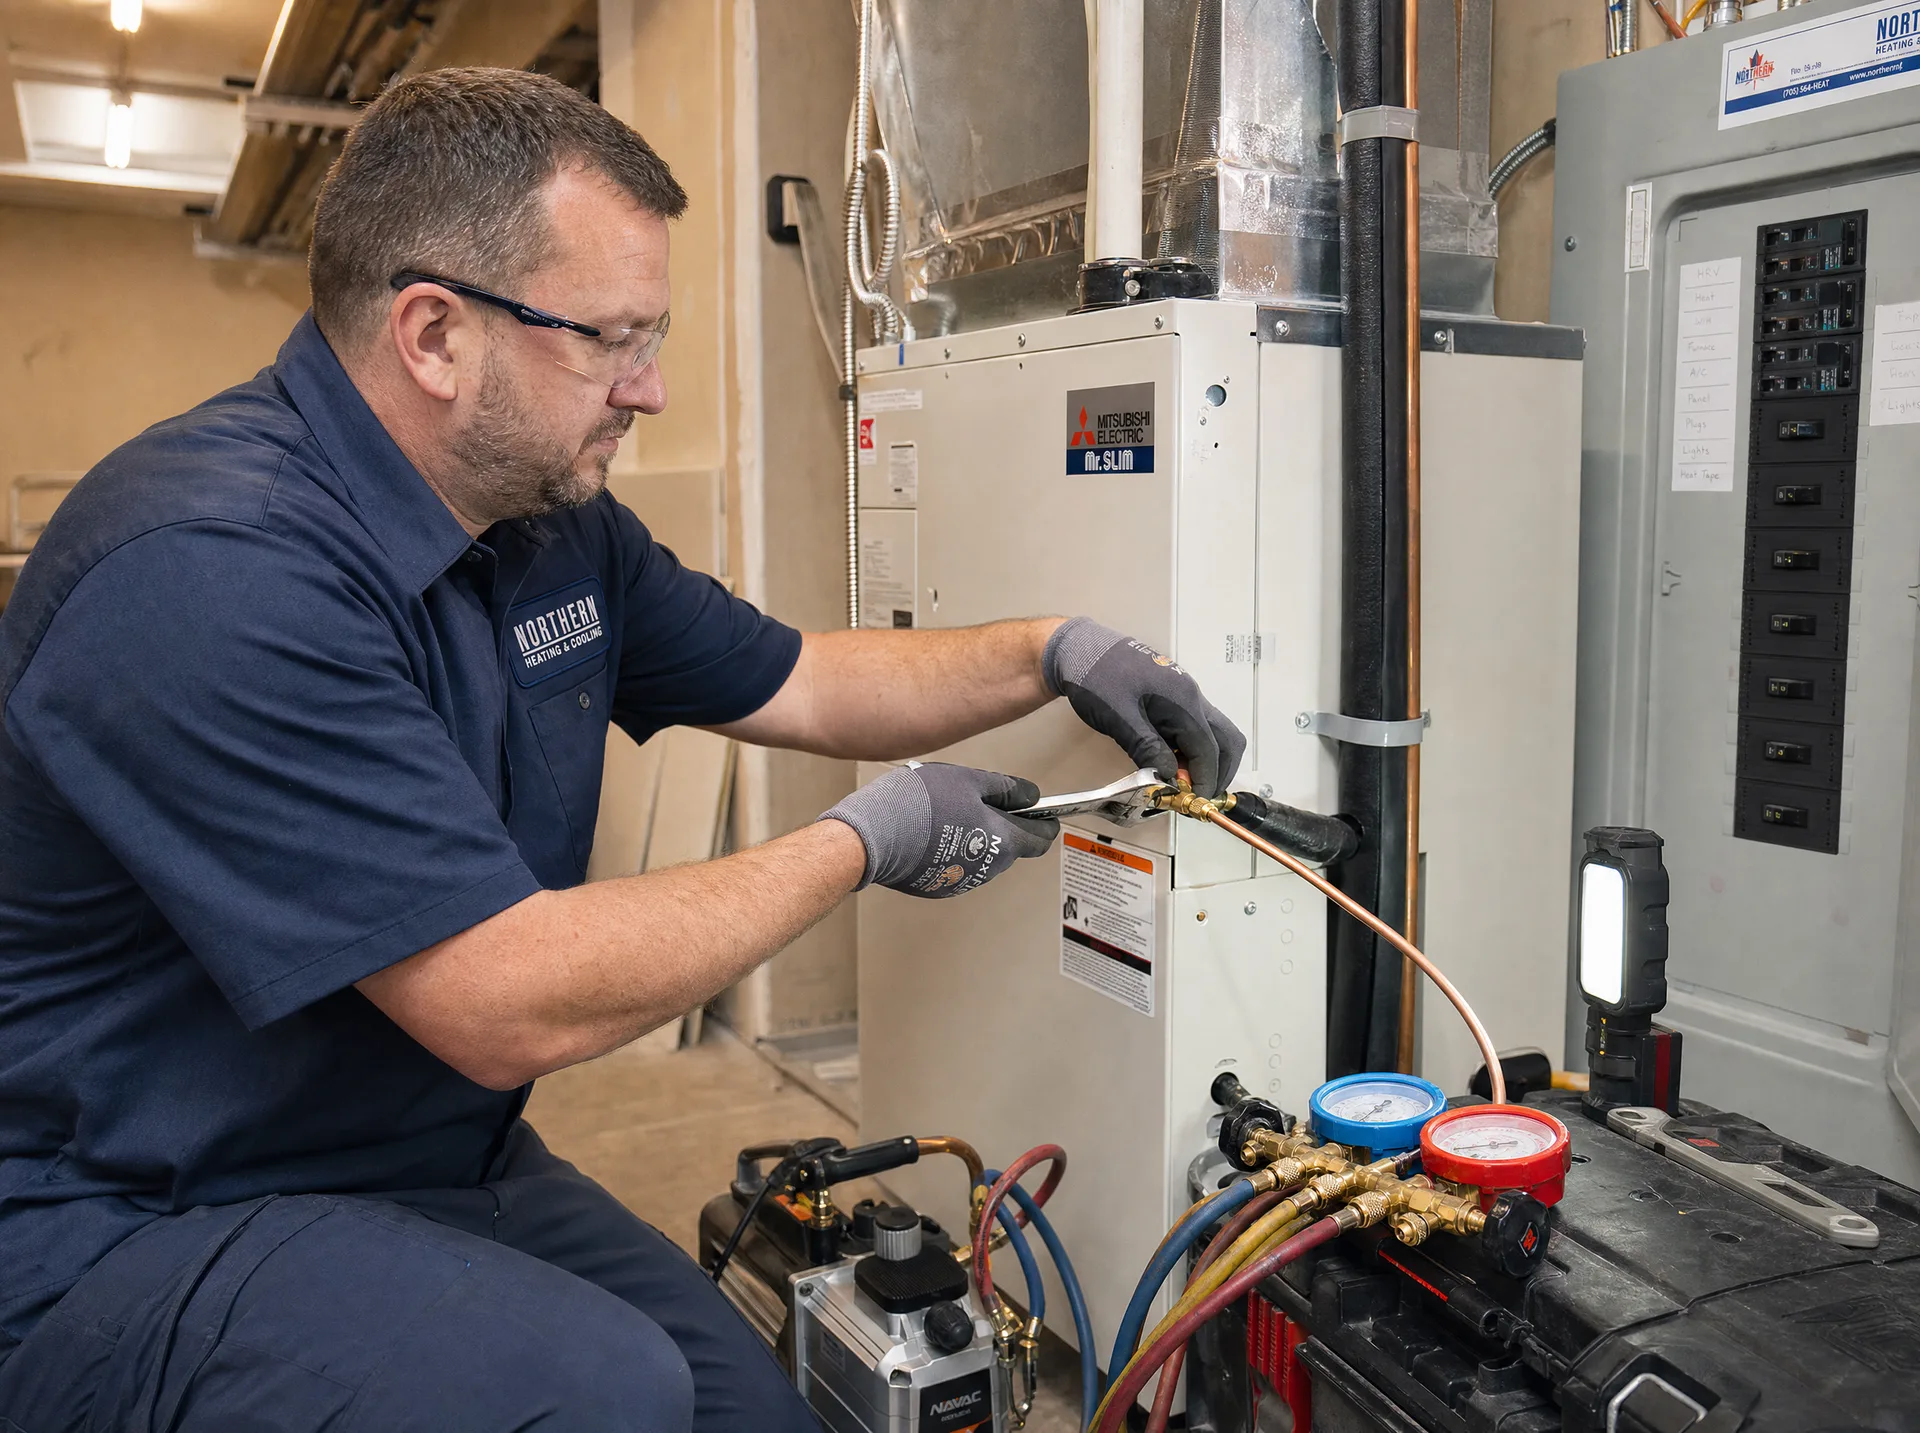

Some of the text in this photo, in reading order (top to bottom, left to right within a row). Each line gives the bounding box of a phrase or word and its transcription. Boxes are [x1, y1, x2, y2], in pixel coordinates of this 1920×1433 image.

[1875, 38, 1913, 54] HEATING
[1689, 368, 1708, 377] A/C
[1097, 411, 1150, 429] MITSUBISHI
[1686, 418, 1707, 433] Plugs
[1097, 428, 1144, 445] ELECTRIC
[1682, 445, 1710, 460] Lights
[513, 594, 599, 653] NORTHERN
[525, 626, 603, 668] HEATING & COOLING
[929, 1390, 982, 1416] NAVAC
